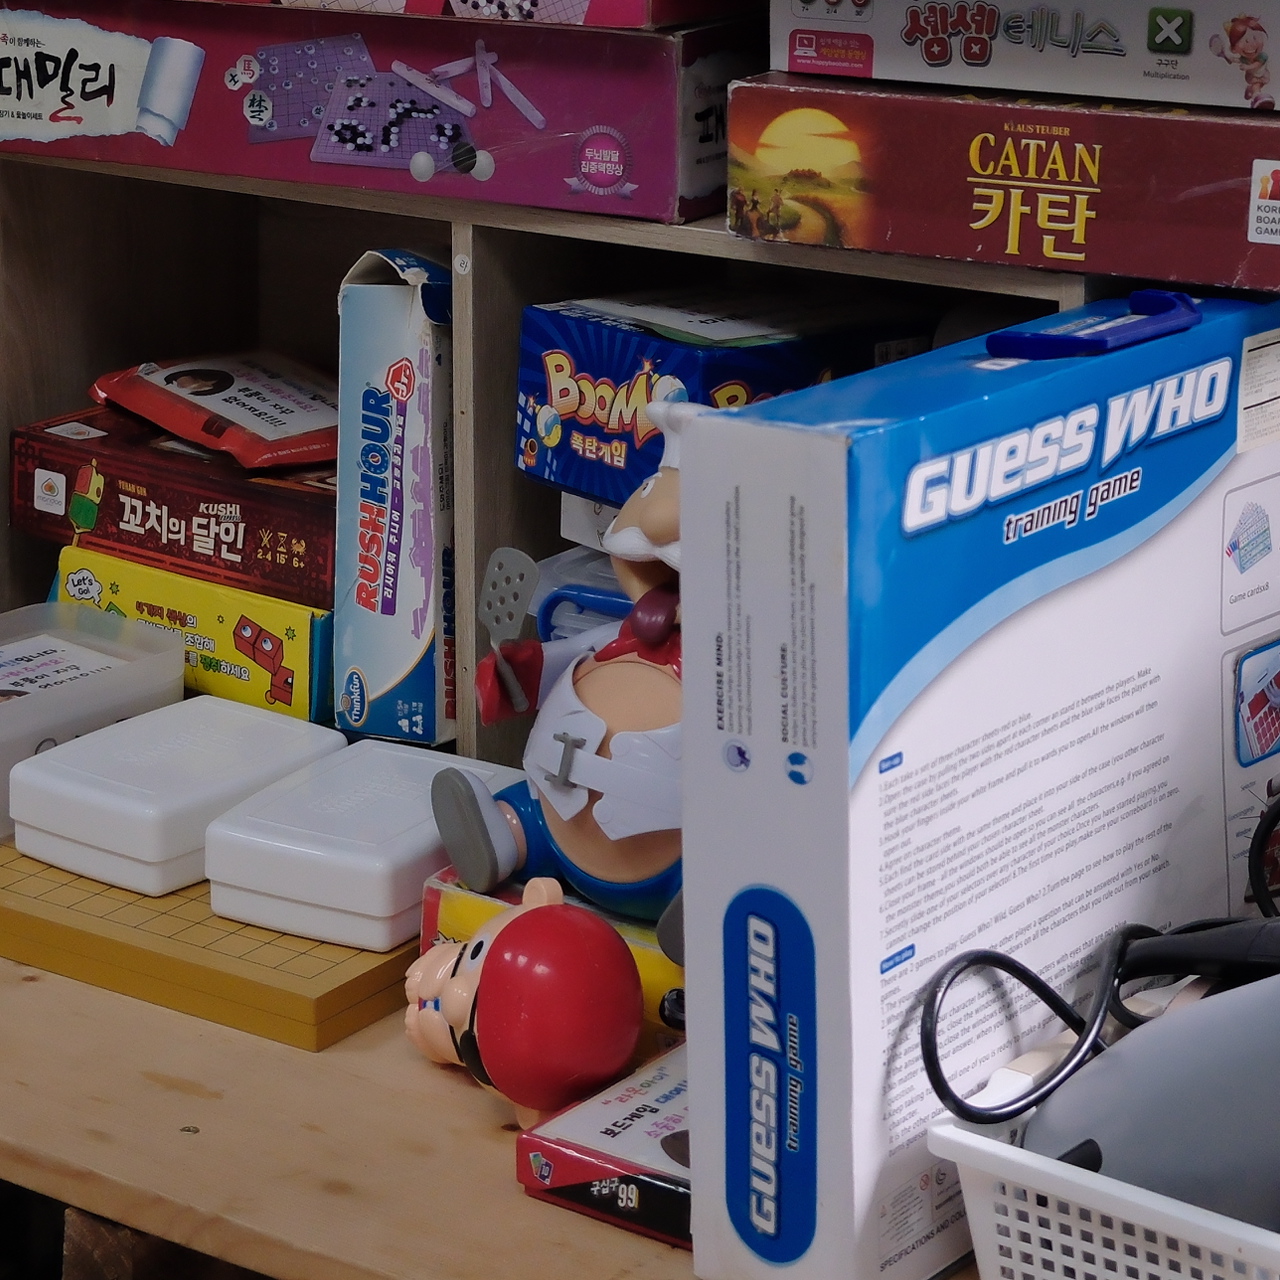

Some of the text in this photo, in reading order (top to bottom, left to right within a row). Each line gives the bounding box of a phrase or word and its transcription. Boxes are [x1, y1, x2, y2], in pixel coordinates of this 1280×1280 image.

[1143, 70, 1191, 82] Multiplication
[1155, 58, 1179, 70] 구구단
[1004, 122, 1070, 137] KLAUS TEUBER
[581, 161, 623, 176] 집중력향상
[585, 148, 620, 162] 두뇌발달
[968, 132, 1103, 185] CATAN
[969, 187, 1096, 262] 카탄
[391, 366, 411, 397] Jr.
[542, 349, 663, 450] BOOM
[1101, 357, 1233, 469] WHO
[571, 430, 628, 469] 폭탄게임
[199, 502, 240, 516] KUSHI
[356, 386, 393, 613] RUSH HOUR
[1003, 467, 1142, 545] training game
[119, 494, 246, 563] 꼬치의 달인
[382, 511, 400, 598] 러시아워 주니어
[71, 575, 93, 588] Let's
[1229, 581, 1270, 605] Game cardsx8
[200, 653, 250, 681] 쟁취하세요
[1137, 667, 1151, 679] Make
[1149, 674, 1161, 685] with
[716, 670, 725, 731] EXERCISE
[1145, 700, 1158, 712] then
[780, 703, 789, 743] SOCIAL
[1140, 733, 1165, 750] character
[1162, 755, 1170, 764] on
[1145, 822, 1173, 841] rest the
[1124, 871, 1151, 889] from your
[1134, 861, 1143, 871] Yes
[747, 914, 782, 1054] WHO
[786, 1013, 804, 1153] training game
[600, 1104, 660, 1138] 보드게임
[645, 1114, 685, 1138] 소중히
[590, 1177, 639, 1208] 구십구 99
[880, 1219, 950, 1272] SPECIFICATIONS AND
